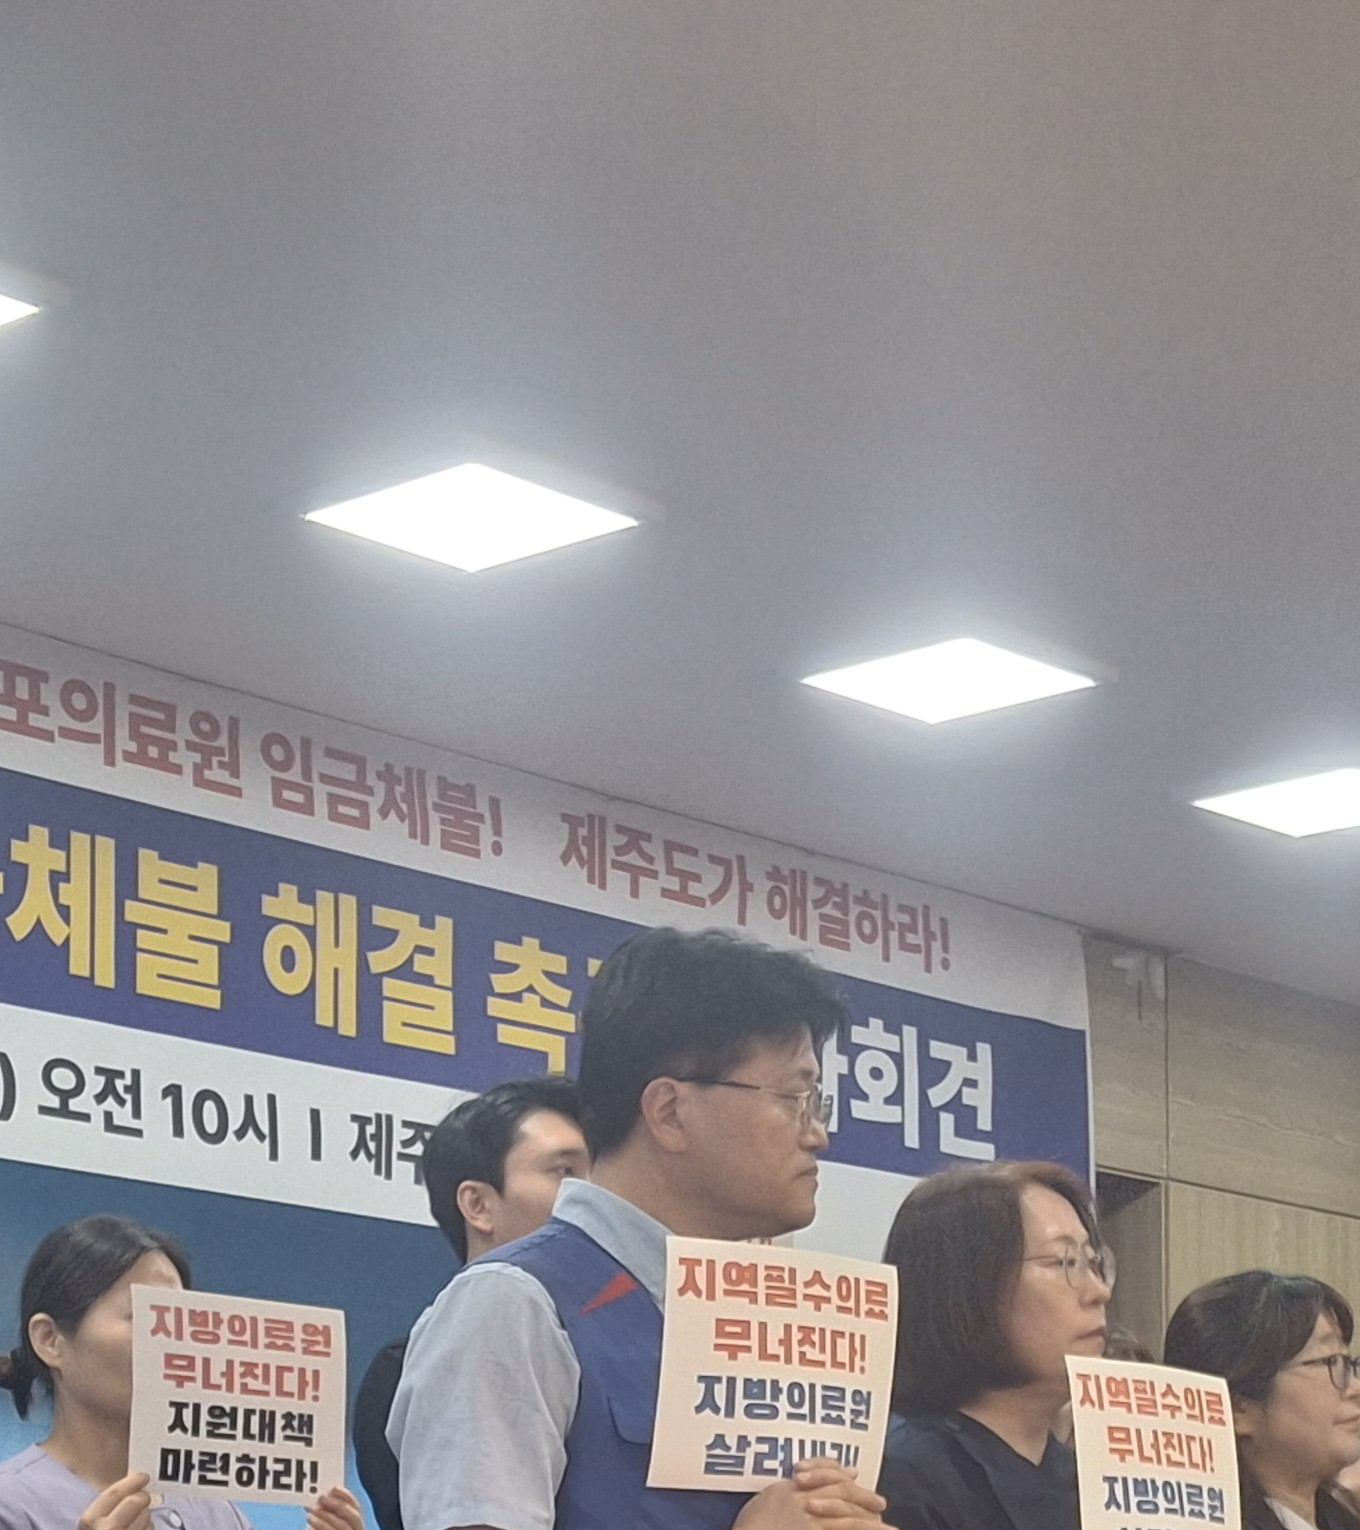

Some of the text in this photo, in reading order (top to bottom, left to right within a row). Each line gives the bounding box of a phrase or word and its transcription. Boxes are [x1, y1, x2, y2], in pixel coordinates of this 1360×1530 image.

[259, 731, 505, 859] 임금체불!
[560, 812, 754, 927] 제주도가
[764, 861, 952, 975] 해결하라!
[260, 881, 457, 1056] 해결
[486, 935, 603, 1077] 촉
[37, 1056, 145, 1139] 오전
[160, 1082, 280, 1162] 10시
[677, 1256, 889, 1322] 지역필수의료
[149, 1304, 332, 1359] 지방의료원
[713, 1317, 867, 1376] 무너진다!
[162, 1352, 321, 1403] 무너진다!
[694, 1374, 872, 1432] 지방의료원
[1075, 1372, 1227, 1428] 지역필수의료
[167, 1400, 314, 1448] 지원대책
[1106, 1425, 1216, 1474] 무너진다!
[158, 1446, 319, 1495] 마련하라!
[1102, 1475, 1225, 1525] 지방의료원
